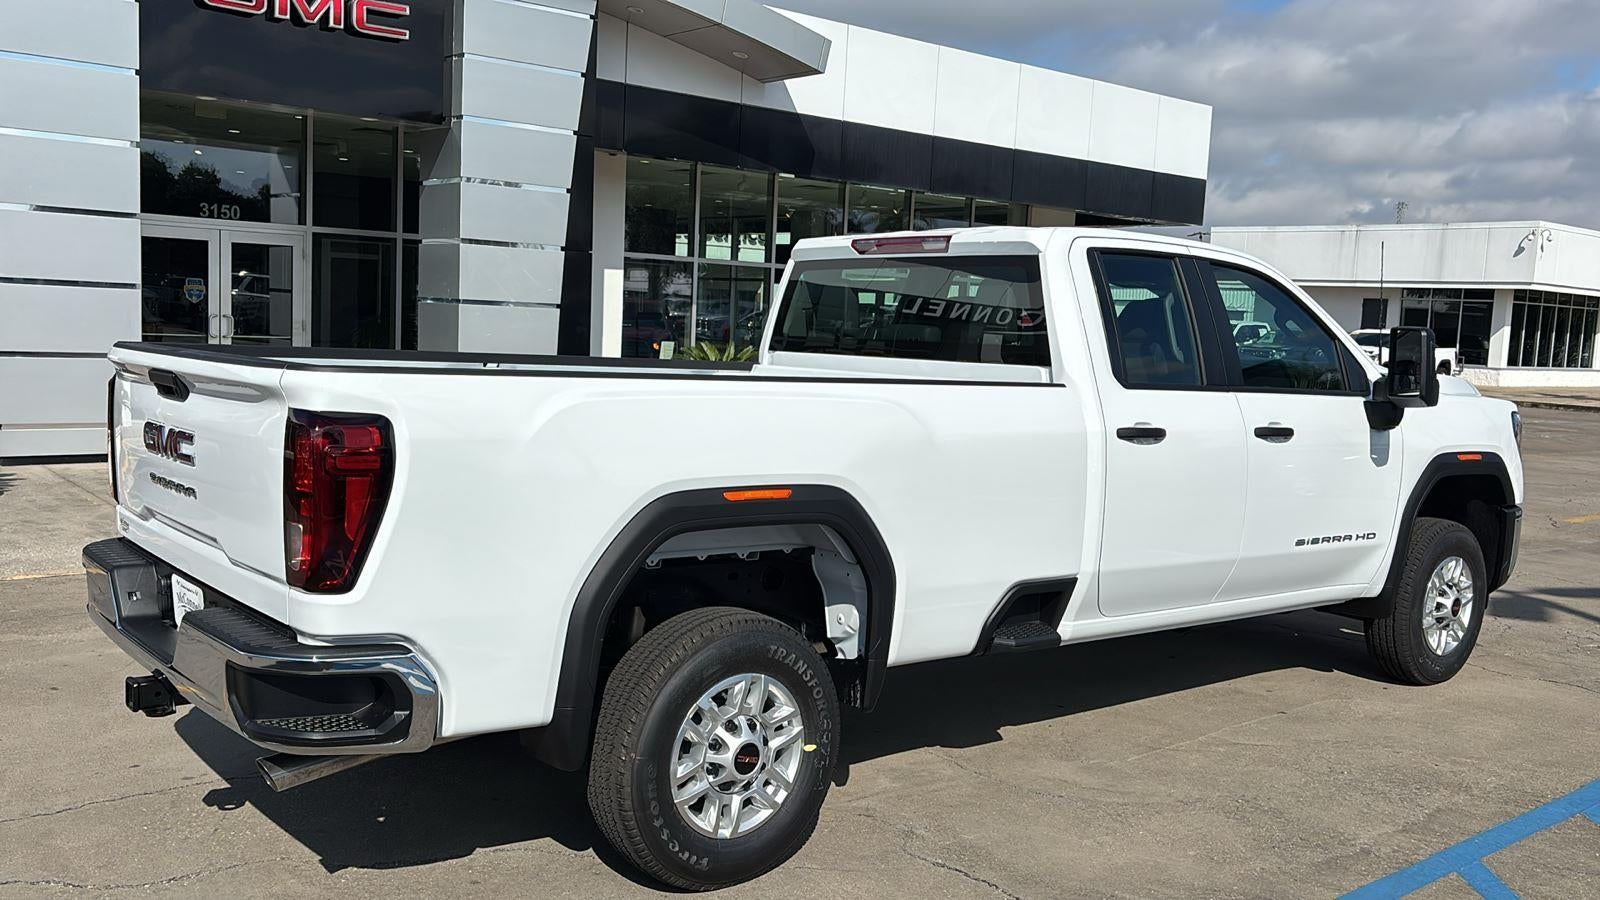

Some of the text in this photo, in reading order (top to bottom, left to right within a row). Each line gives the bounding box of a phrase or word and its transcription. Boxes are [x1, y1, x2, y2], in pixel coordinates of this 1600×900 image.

[199, 203, 241, 219] 3150
[143, 419, 196, 468] GMC
[1294, 532, 1377, 547] SIERRA HD
[647, 761, 710, 872] Firestone
